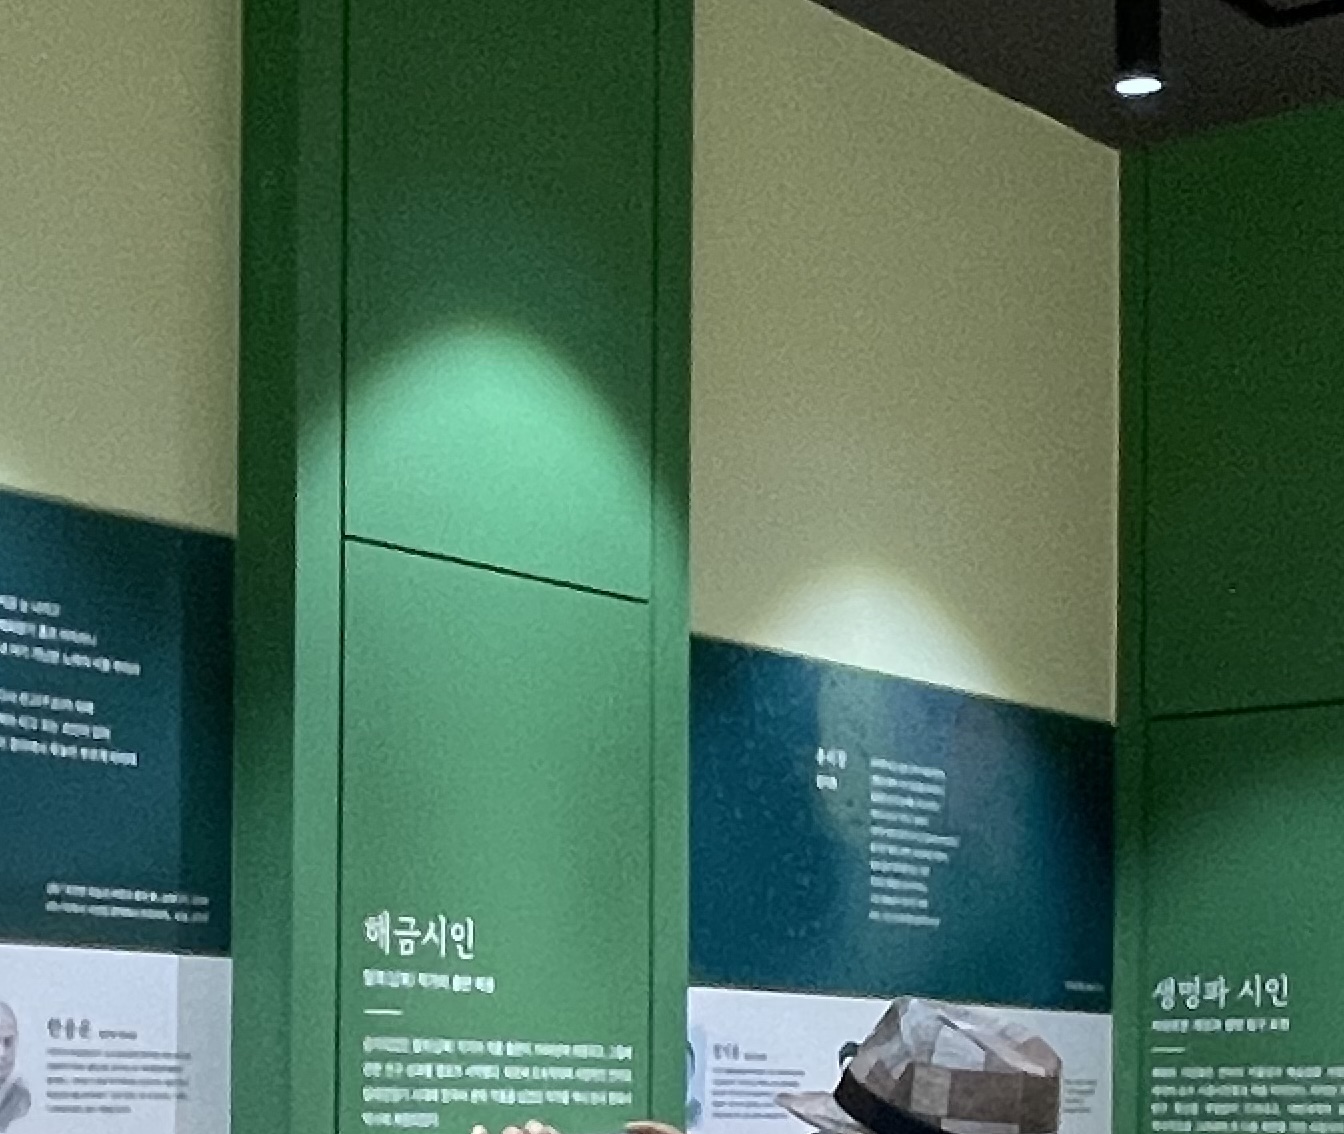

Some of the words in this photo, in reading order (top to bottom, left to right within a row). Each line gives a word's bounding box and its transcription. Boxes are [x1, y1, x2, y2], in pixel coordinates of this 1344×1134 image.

[364, 910, 476, 960] 해금시인
[1152, 973, 1231, 1011] 생명파
[1236, 972, 1289, 1009] 시인
